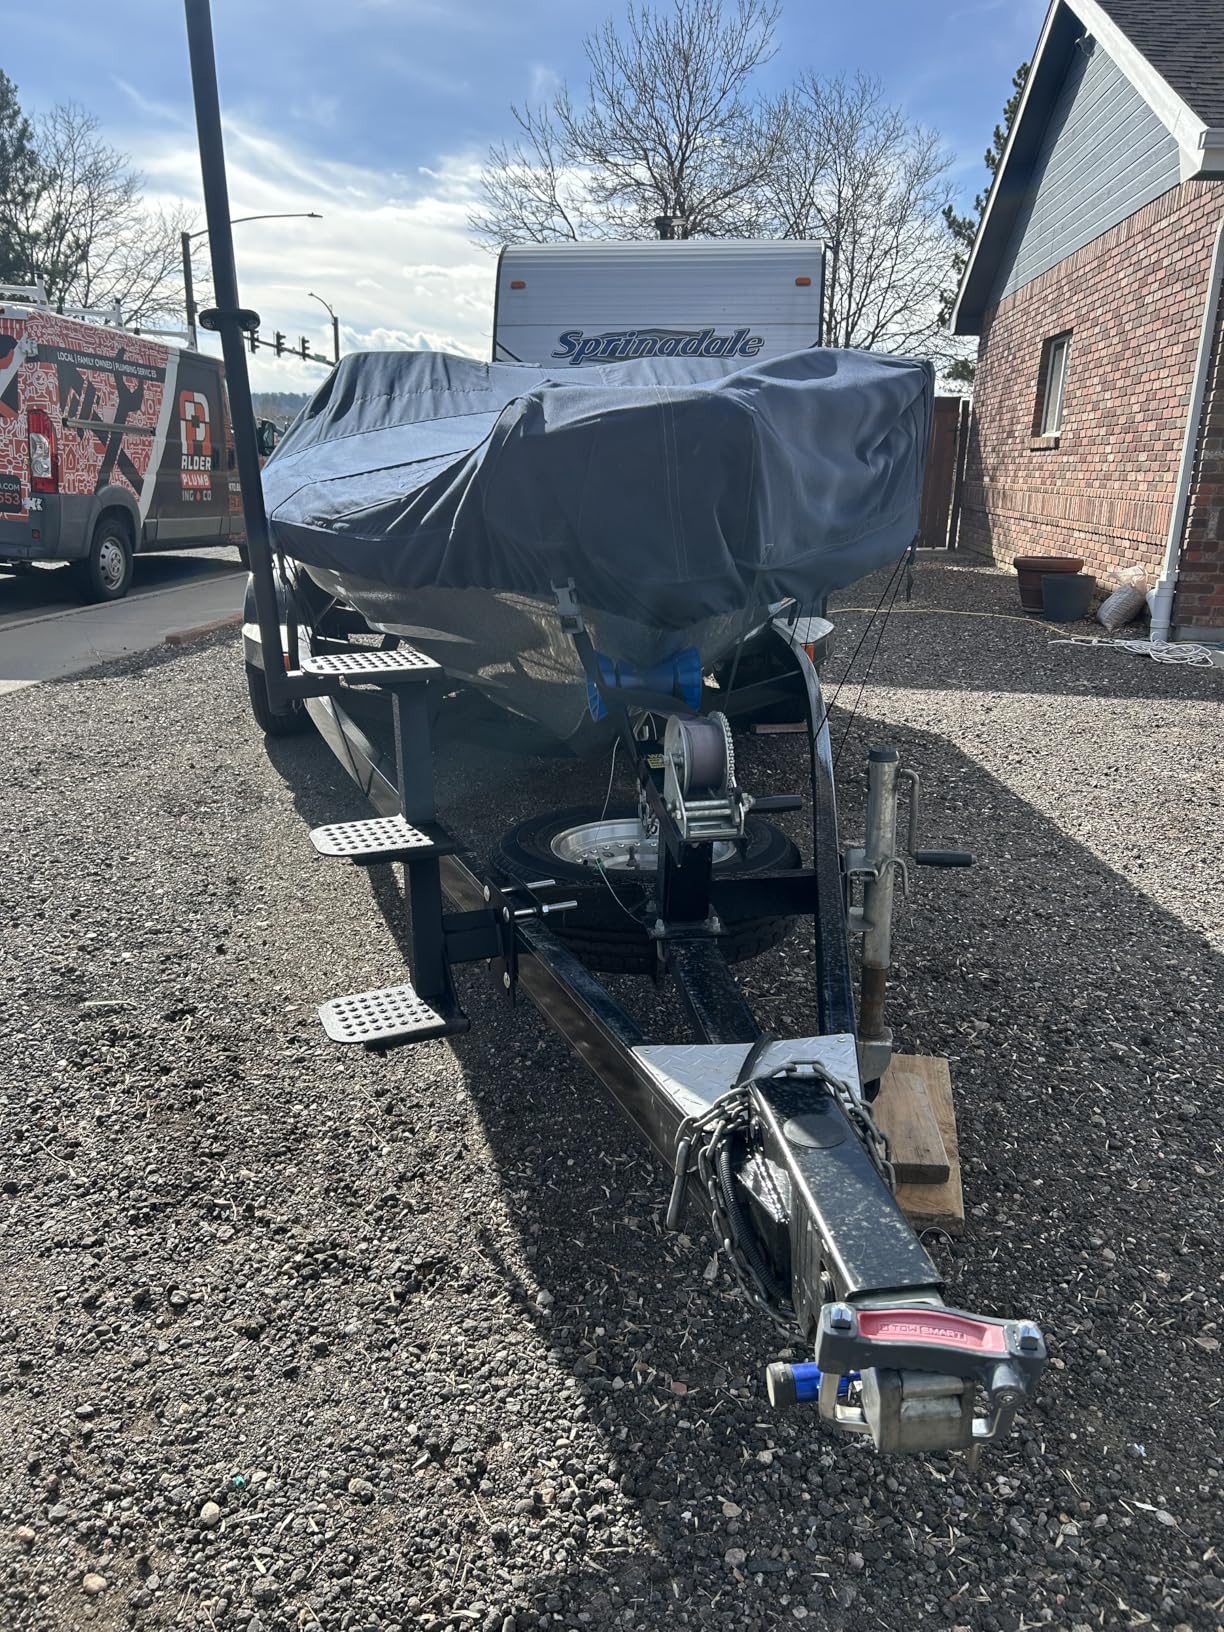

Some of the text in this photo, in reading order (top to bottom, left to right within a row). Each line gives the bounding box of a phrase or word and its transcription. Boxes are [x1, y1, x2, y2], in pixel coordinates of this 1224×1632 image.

[551, 328, 765, 365] Springdale
[57, 351, 157, 378] LOCAL FAMILY OWNED PLUMBING SERVICES
[181, 455, 212, 471] ALDER
[0, 482, 20, 491] .COM
[182, 473, 210, 486] PLUMB
[181, 490, 212, 502] ING CO
[920, 1325, 963, 1339] SMART
